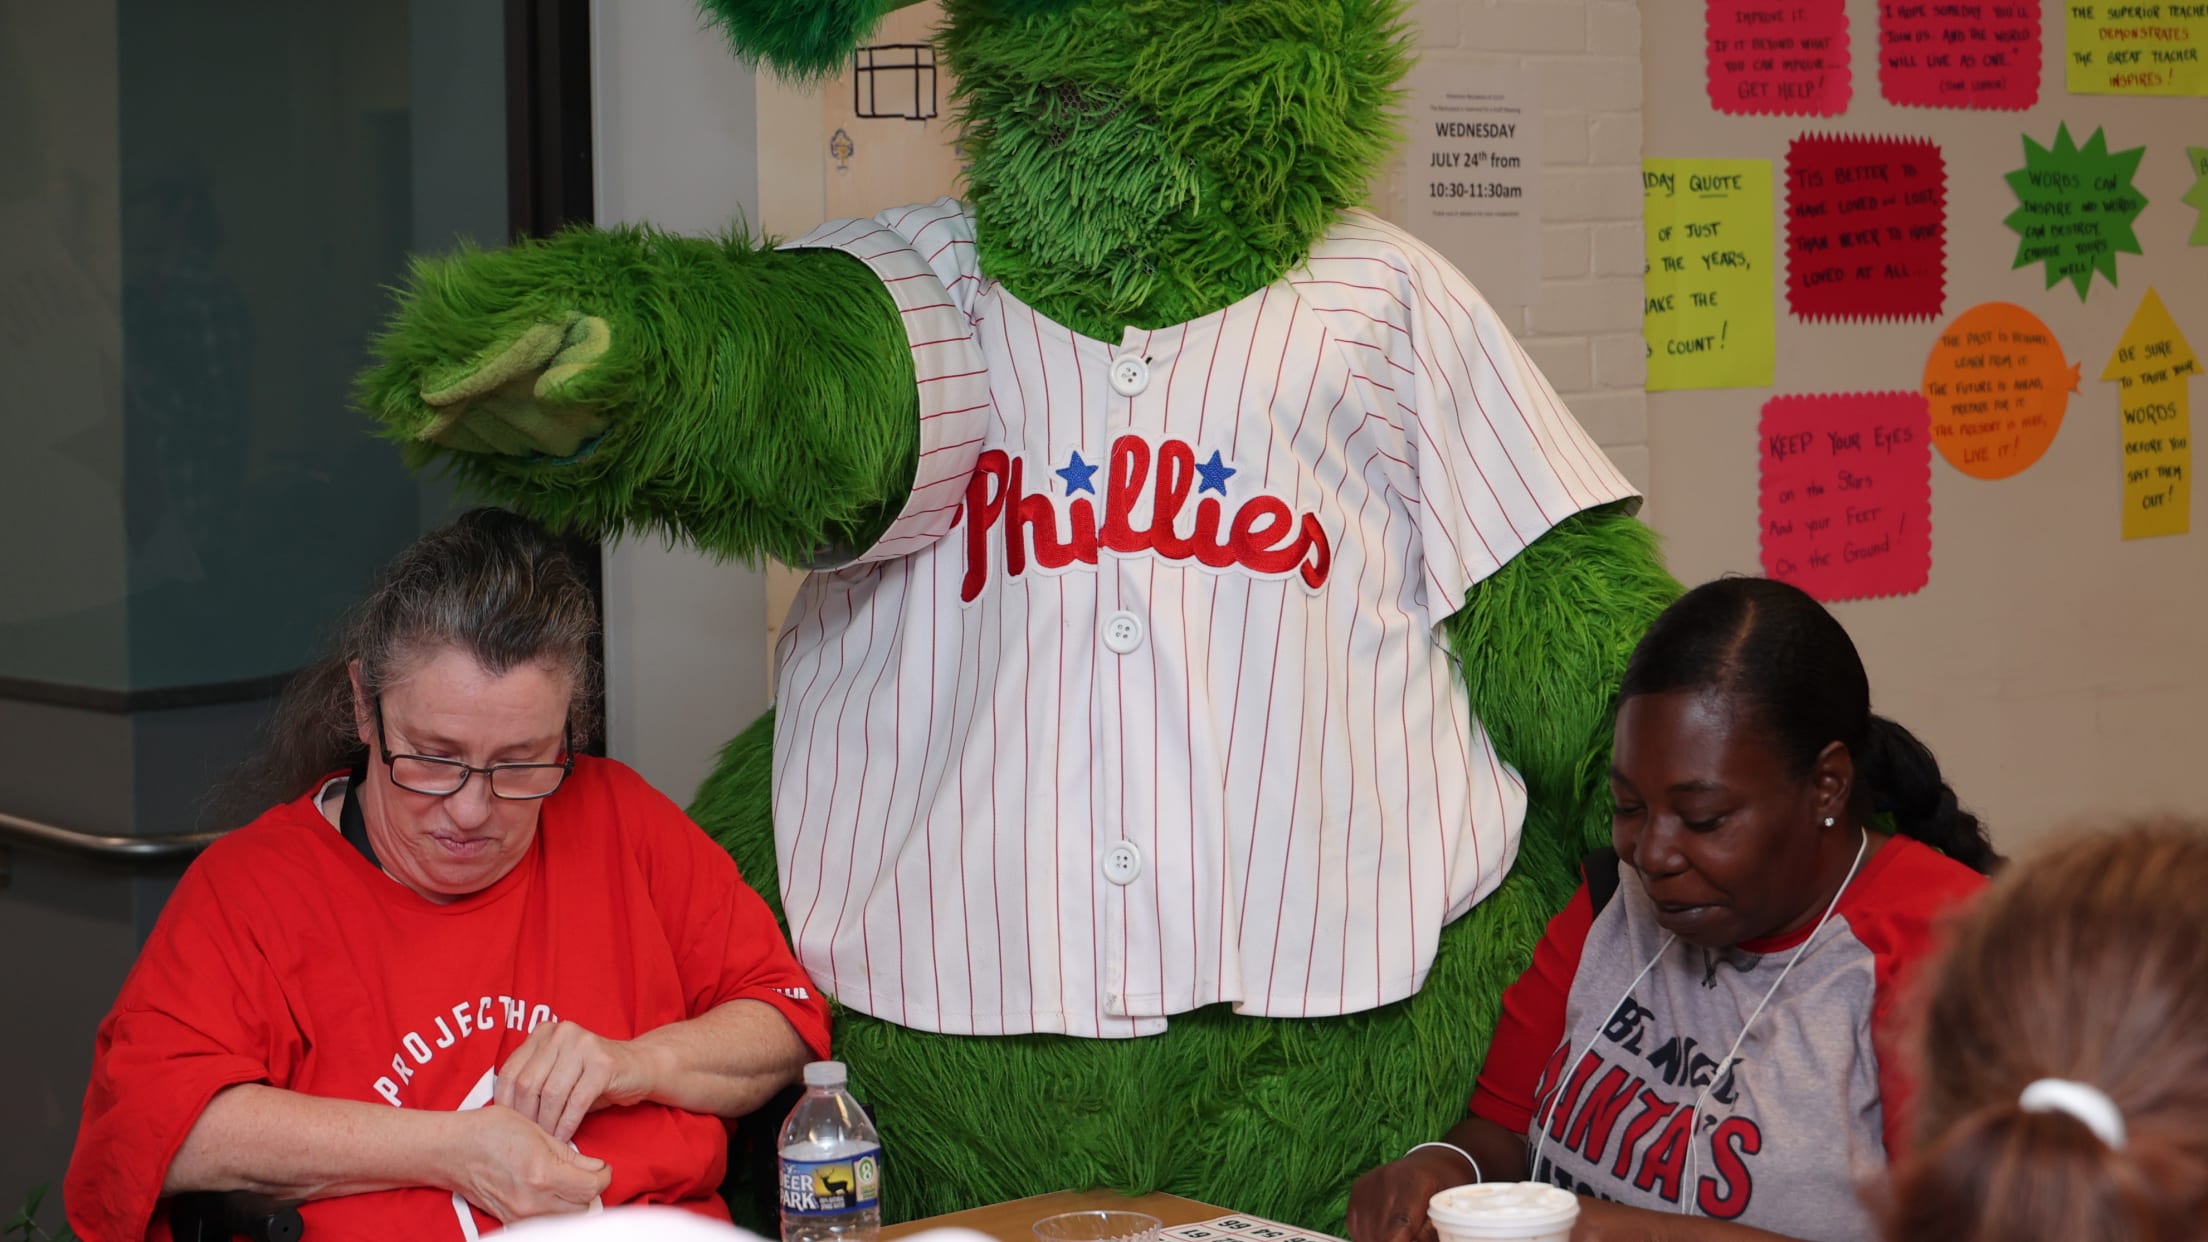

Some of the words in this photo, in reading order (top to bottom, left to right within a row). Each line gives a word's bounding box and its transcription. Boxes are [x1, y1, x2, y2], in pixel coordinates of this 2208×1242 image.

[2072, 5, 2095, 20] THE
[2107, 5, 2160, 20] SUPERIOR
[2098, 25, 2189, 42] DEMONSTRATES
[1888, 55, 1917, 69] WILL
[2073, 52, 2093, 67] THE
[2107, 50, 2142, 65] GREAT
[2151, 48, 2199, 64] TEACHER
[1738, 80, 1769, 99] GET
[1435, 122, 1515, 138] WEDNESDAY
[1430, 152, 1460, 167] JULY
[1464, 151, 1487, 167] 24th
[1491, 152, 1521, 168] from
[1429, 182, 1522, 198] 10:30-11:30am
[1689, 174, 1743, 192] QUOTE
[2028, 171, 2080, 195] WORDS
[2094, 173, 2117, 191] CAN
[1658, 226, 1673, 241] OF
[1684, 221, 1721, 238] JUST
[1661, 256, 1685, 272] THE
[1702, 251, 1750, 271] YEARS,
[1856, 265, 1873, 279] AT
[1690, 291, 1717, 308] THE
[2123, 402, 2176, 425] WORDS
[1769, 431, 1813, 462] KEEP
[1827, 431, 1861, 457] YOUR
[1964, 447, 1989, 463] LIVE
[953, 434, 1331, 604] Phillies
[781, 1174, 814, 1192] EER
[781, 1191, 817, 1212] ARK
